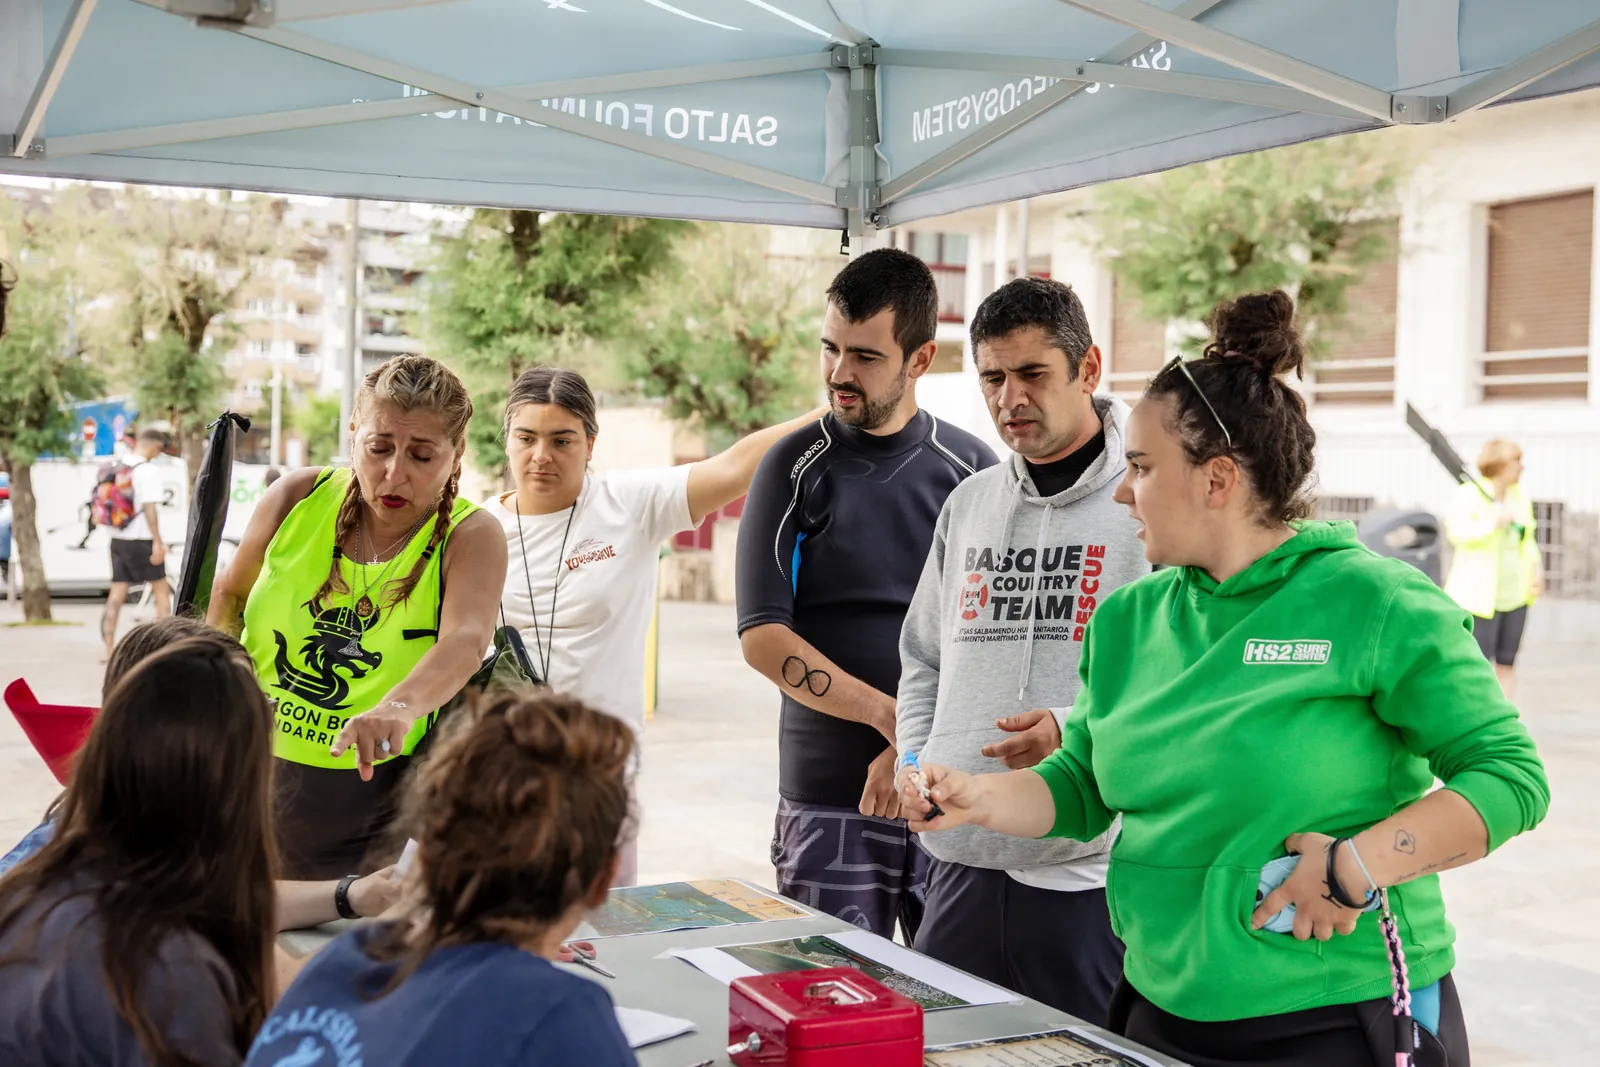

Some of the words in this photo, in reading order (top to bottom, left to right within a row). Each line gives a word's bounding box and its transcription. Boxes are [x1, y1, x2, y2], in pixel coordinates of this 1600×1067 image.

[964, 545, 1083, 573] BASQUE
[990, 595, 1075, 621] TEAM
[1246, 643, 1293, 661] HS2
[1294, 644, 1328, 654] SURF
[1292, 653, 1326, 661] CENTER
